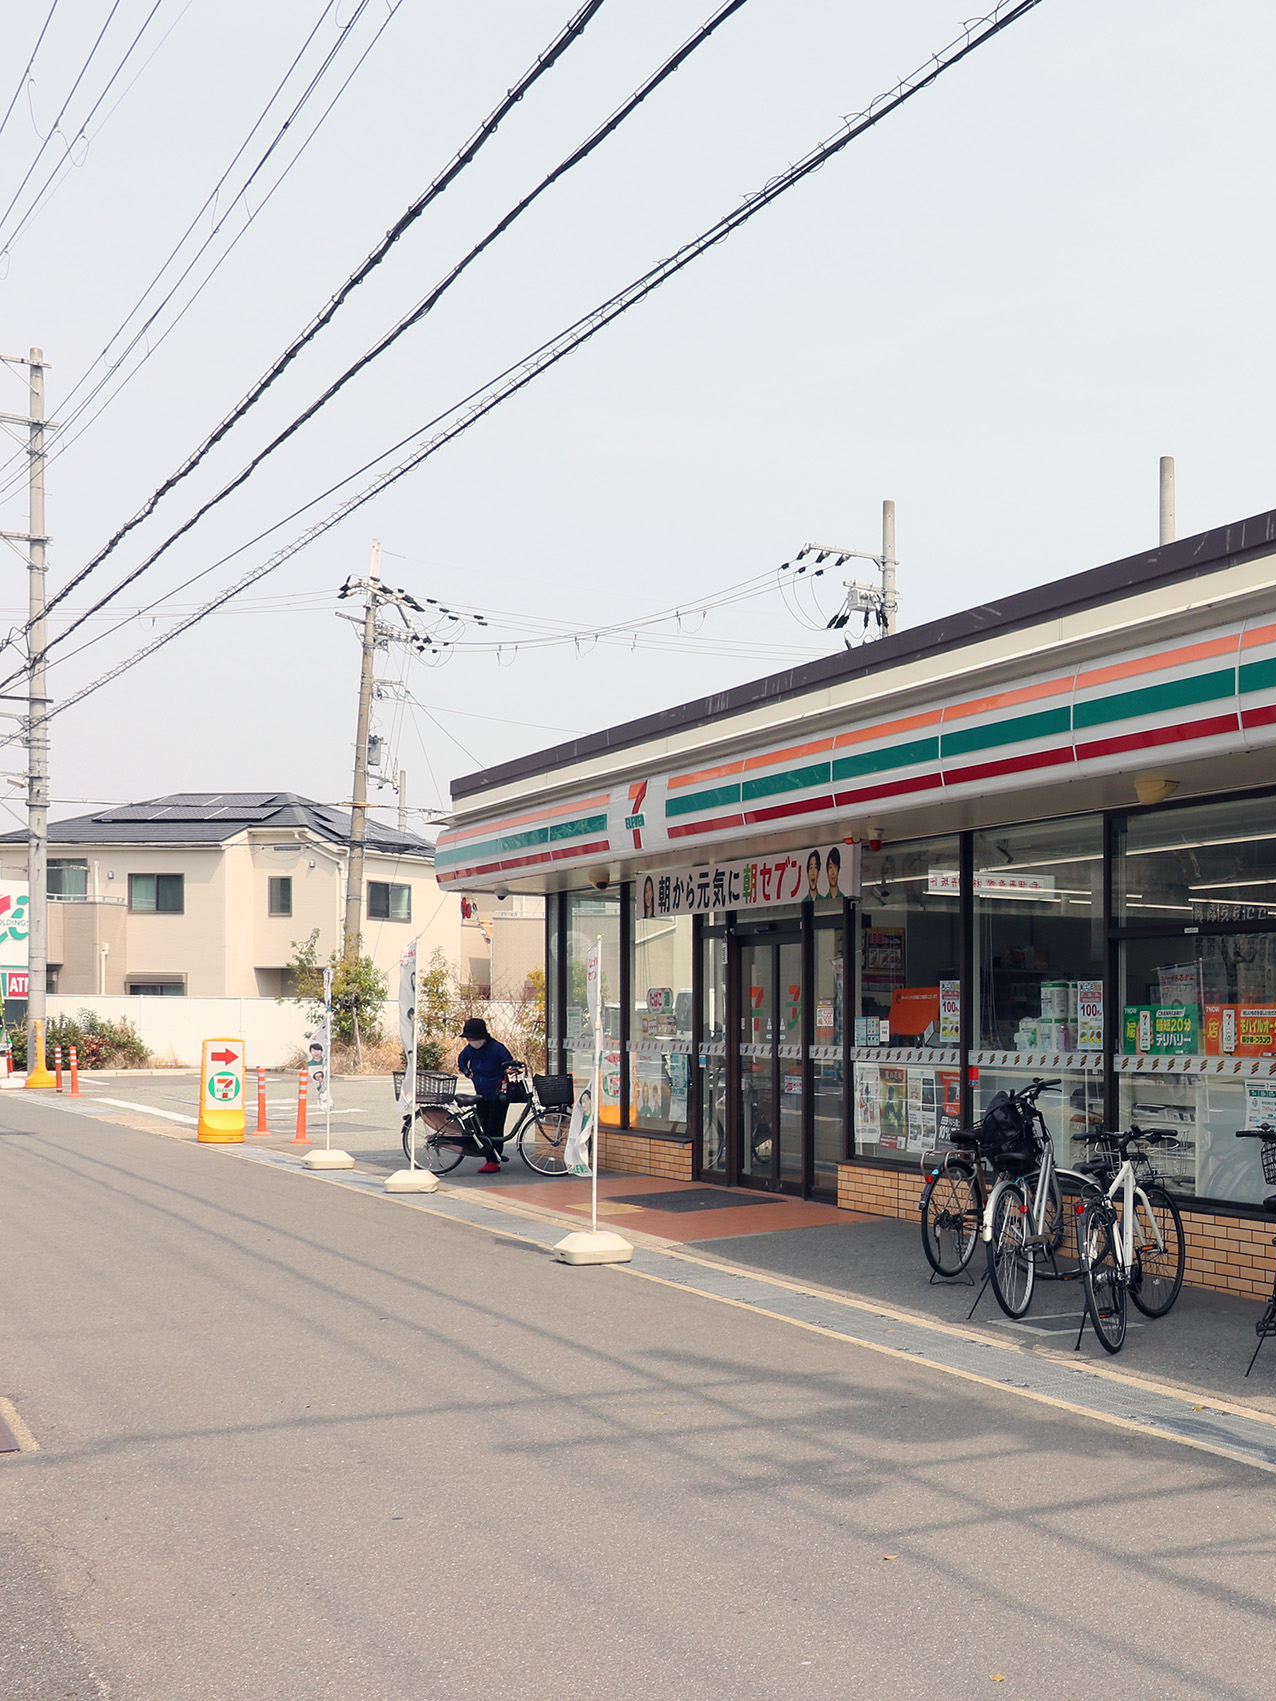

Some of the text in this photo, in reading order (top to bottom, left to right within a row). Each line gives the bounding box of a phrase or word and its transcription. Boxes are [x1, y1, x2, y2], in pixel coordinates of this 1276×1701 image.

[658, 857, 801, 913] 朝から元気に朝セブン
[1156, 1018, 1191, 1032] 最短20分
[1156, 1033, 1191, 1046] デリバリー
